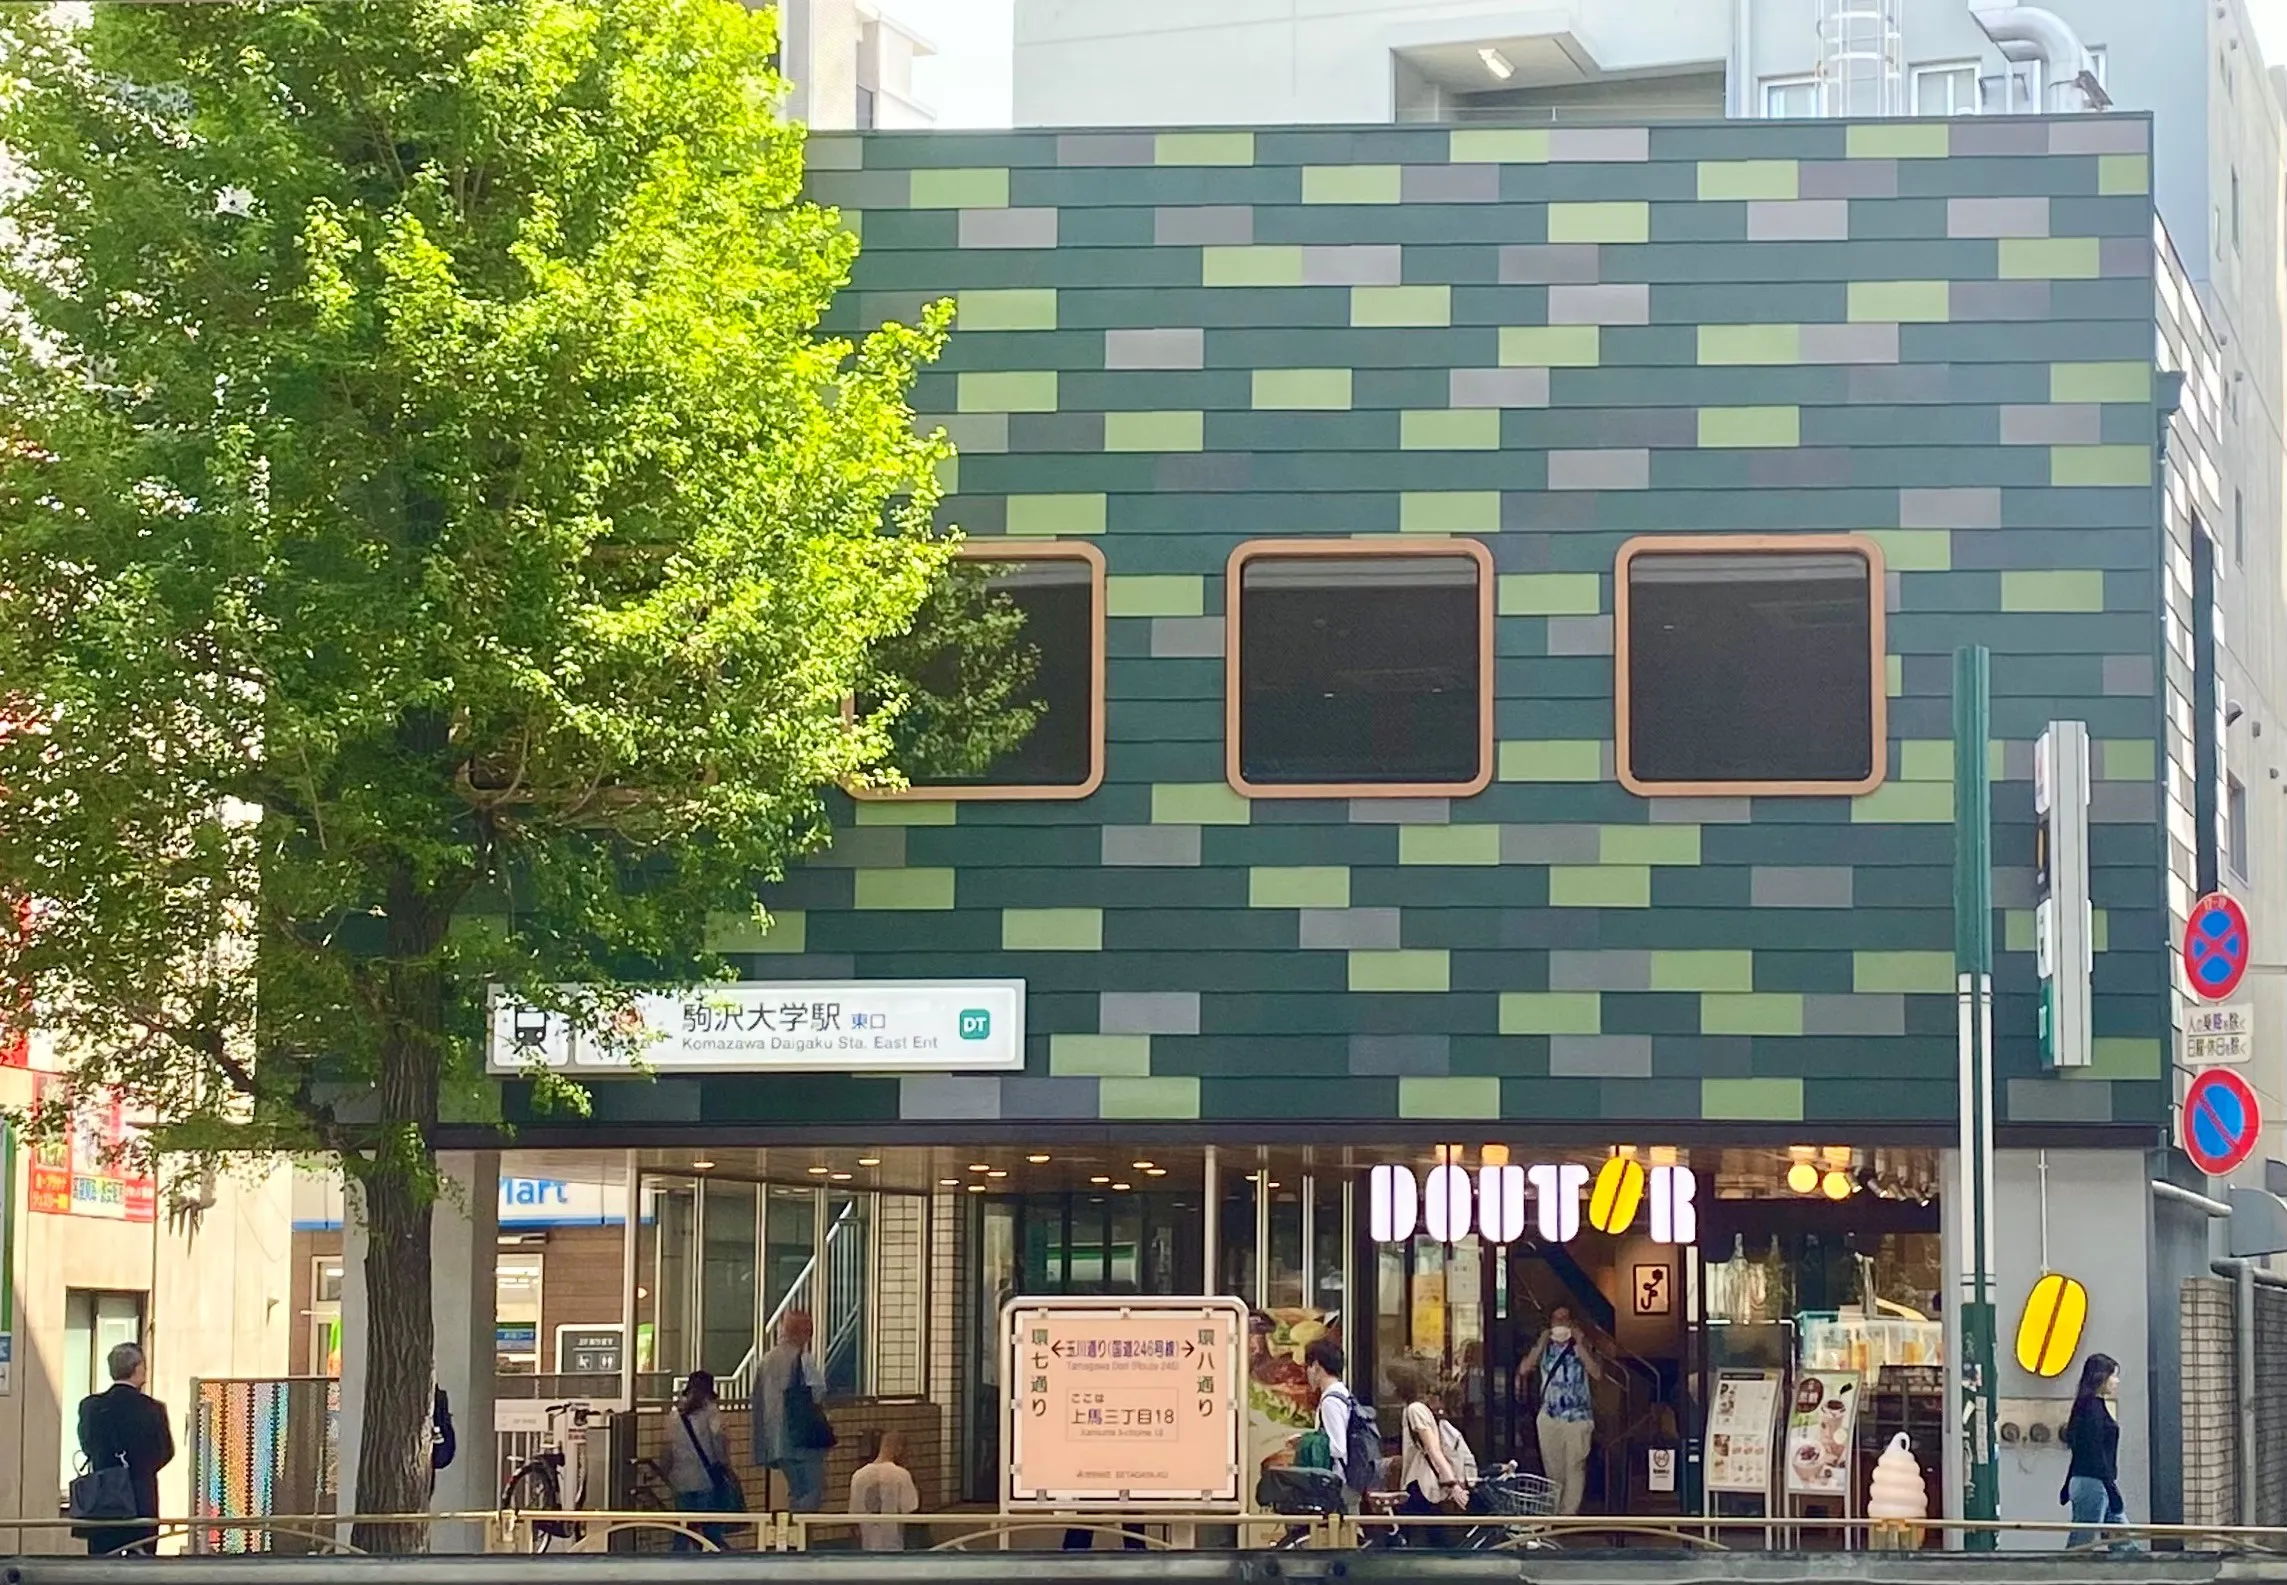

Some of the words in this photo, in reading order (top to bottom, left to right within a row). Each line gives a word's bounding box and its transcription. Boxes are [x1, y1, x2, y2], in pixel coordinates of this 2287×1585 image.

[682, 1001, 841, 1033] 駒沢大学駅
[851, 1012, 886, 1030] 東口
[963, 1015, 987, 1033] DT
[682, 1036, 766, 1050] Komazawa
[771, 1036, 833, 1053] Daigaku
[838, 1036, 868, 1049] Sta.
[873, 1036, 908, 1049] East
[1370, 1156, 1696, 1244] DOUTOR
[1030, 1328, 1049, 1417] 環七通り
[1196, 1328, 1215, 1417] 環八通り
[1071, 1393, 1105, 1404] ここは
[1071, 1408, 1175, 1426] 上馬三丁目18
